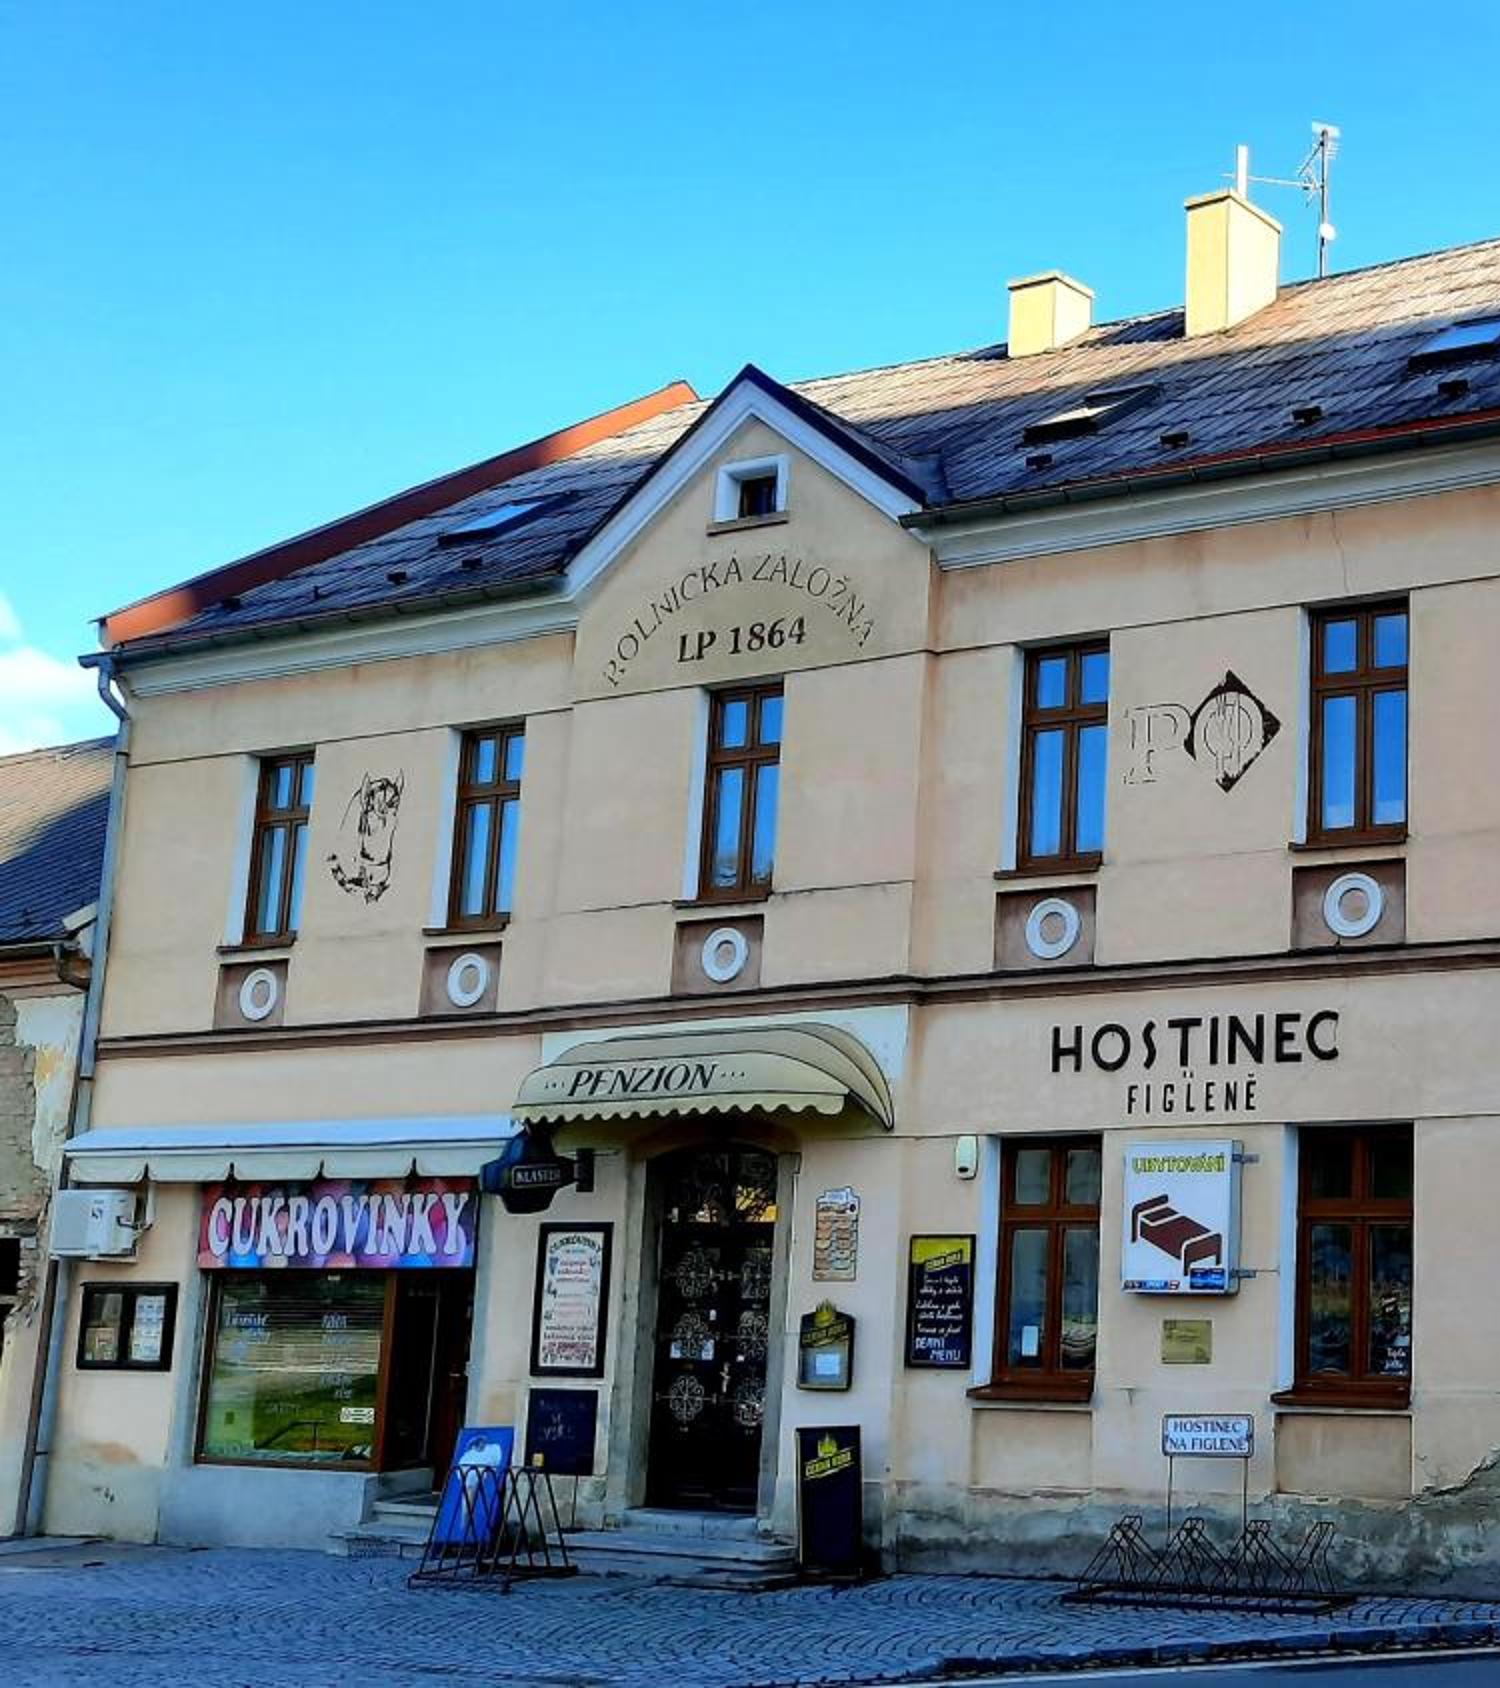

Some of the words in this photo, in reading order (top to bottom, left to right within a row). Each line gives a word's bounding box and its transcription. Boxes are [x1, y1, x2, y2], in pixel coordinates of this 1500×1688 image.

[677, 631, 717, 662] LP
[728, 616, 806, 655] 1864
[1051, 1010, 1339, 1073] HOSTINEC
[1132, 1152, 1225, 1173] UBYTOVÁNÍ
[208, 1193, 469, 1256] CUKROVINKY
[1168, 1437, 1187, 1450] NA
[1173, 1421, 1242, 1433] HOSTINEC
